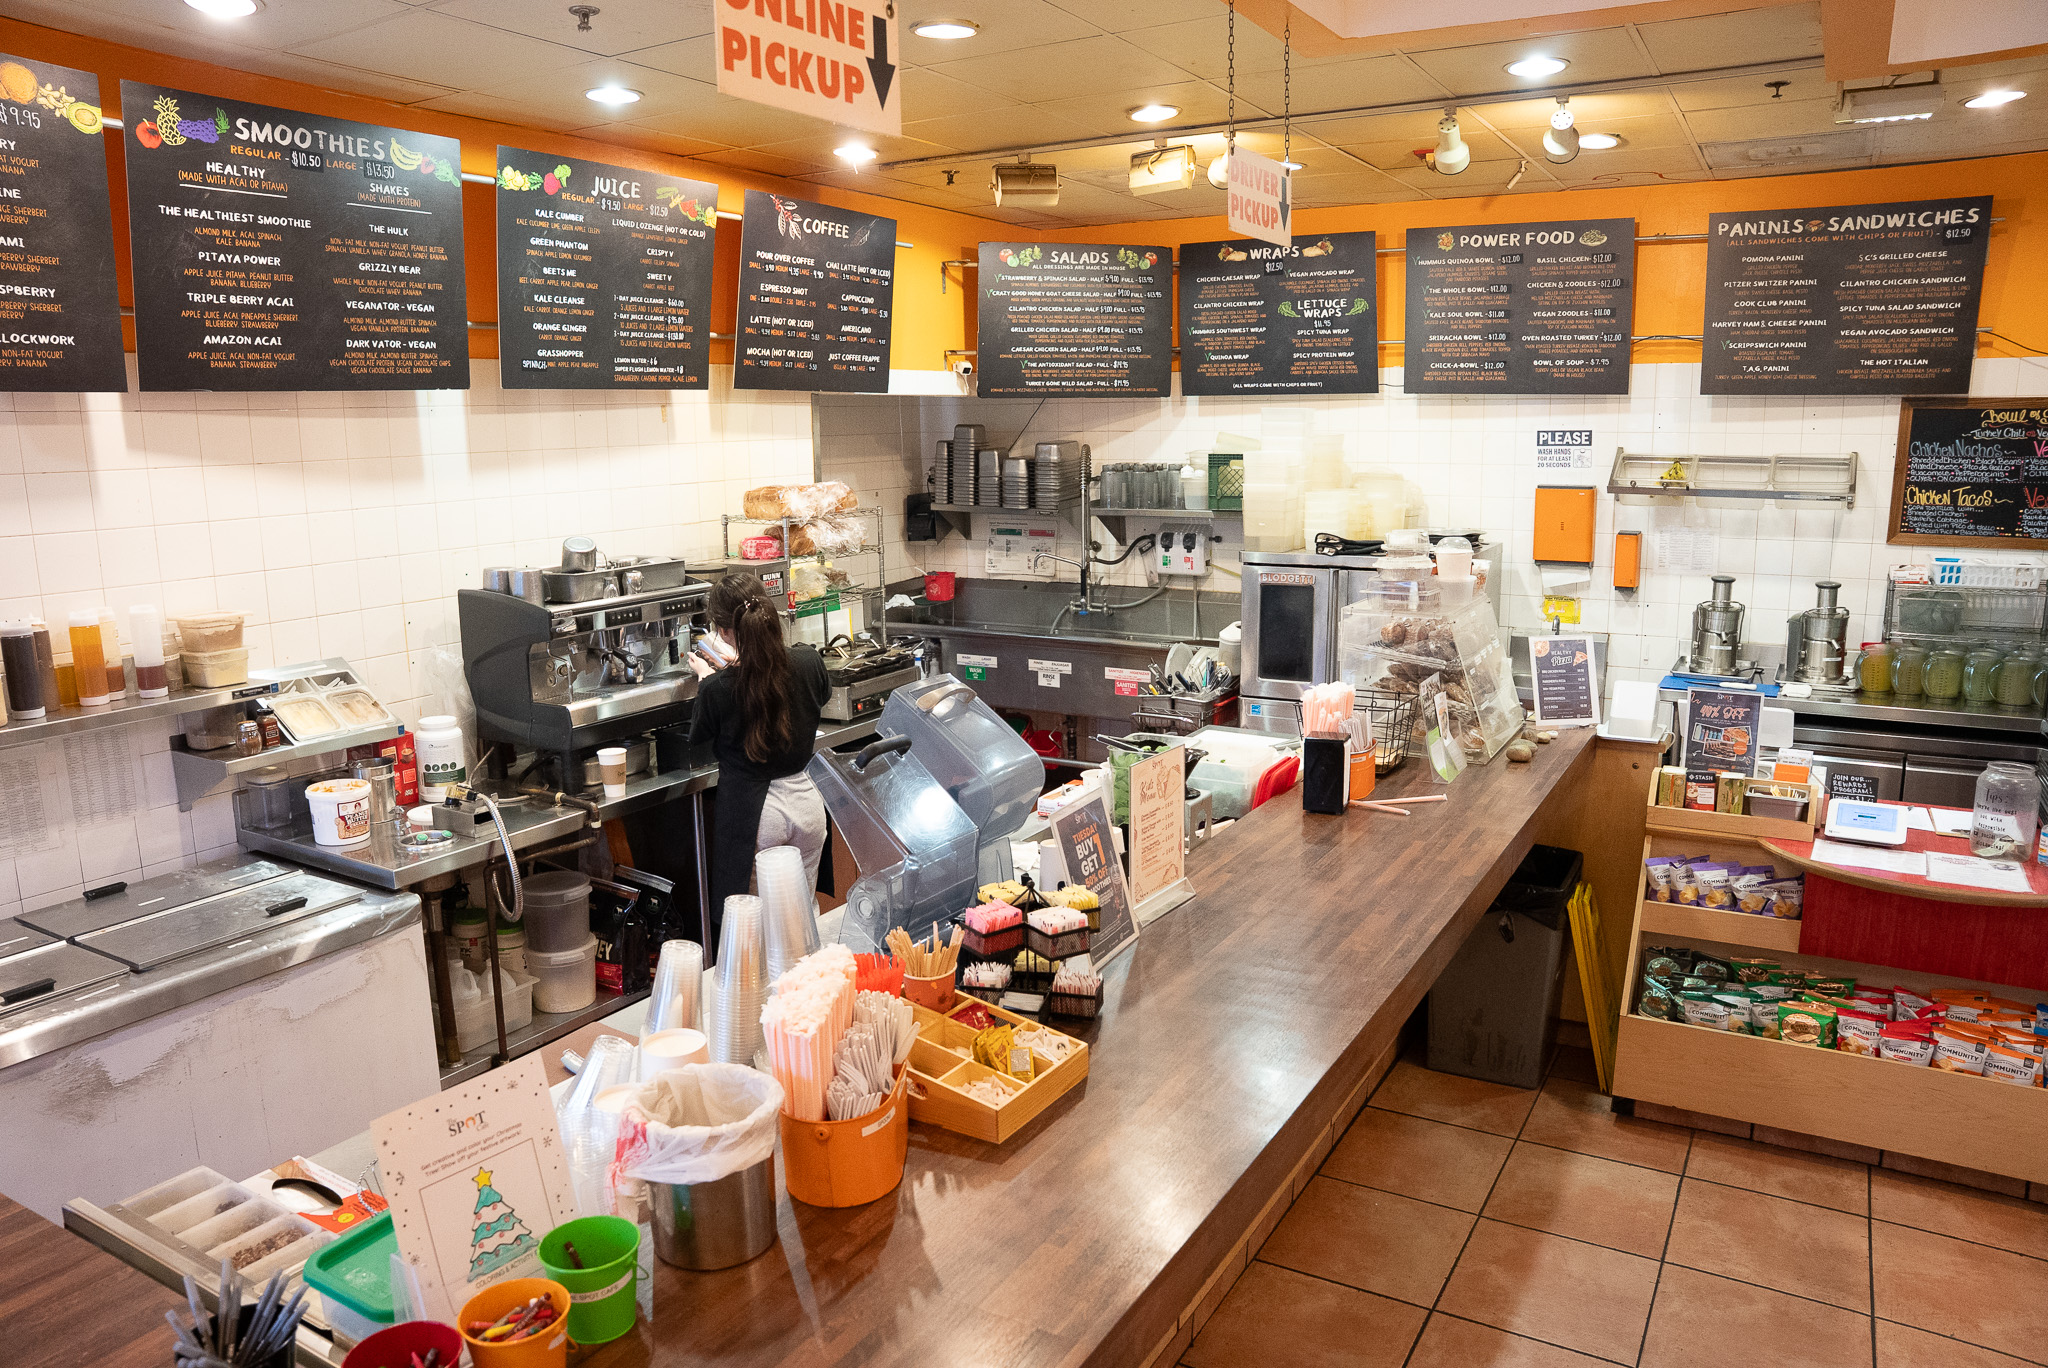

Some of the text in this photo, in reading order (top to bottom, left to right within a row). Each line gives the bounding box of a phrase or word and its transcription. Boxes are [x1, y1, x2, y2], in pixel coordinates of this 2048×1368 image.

[724, 0, 866, 50] LINE
[722, 26, 864, 104] PICKUP
[234, 117, 386, 160] SMOOTHIES
[230, 144, 394, 178] REGULAR $10.50 LARGE $13.50
[206, 162, 266, 178] HEALTHY
[178, 170, 288, 192] (MADE WITH ACAI OR PITAYA)
[1231, 159, 1278, 197] DRIVER
[370, 182, 410, 196] SHAKES
[591, 176, 641, 198] JUICE
[562, 192, 594, 204] REGULAR
[624, 202, 644, 212] LARGE
[158, 205, 312, 228] THE HEALTHIEST SMOOTHIE
[1231, 193, 1278, 230] PICKUP
[803, 218, 850, 238] COFFEE
[1718, 208, 1980, 237] PANINIS SANDWICHES
[530, 237, 588, 250] GREEN PHANTOM
[1460, 230, 1574, 248] POWER FOOD
[1726, 239, 1746, 247] (ALL
[1748, 236, 1802, 246] SANDWICHES
[1832, 234, 1856, 242] WITH
[1946, 228, 1971, 239] $12.50
[198, 252, 281, 266] PITAYA POWER
[756, 250, 815, 266] POUR OVER COFFEE
[1050, 252, 1109, 264] SALADS
[1250, 246, 1300, 260] WRAPS
[1501, 256, 1520, 264] $12.00
[358, 262, 420, 274] GRIZZLY BEAR
[542, 267, 576, 277] BEETS ME
[1600, 280, 1621, 288] $12.00
[1840, 279, 1880, 287] CILANTRO
[1920, 276, 1966, 284] SANDWICH
[760, 283, 808, 296] ESPRESSO SHOT
[842, 294, 874, 304] CAPPUCCINO
[1298, 298, 1347, 309] LETTUCE
[1304, 308, 1342, 318] WRAPS
[533, 323, 587, 333] ORANGE GINGER
[750, 315, 770, 324] LATTE
[772, 316, 786, 326] (HOT
[797, 319, 814, 329] ICED)
[0, 334, 75, 346] LOCKWORK
[1538, 432, 1590, 445] PLEASE
[762, 572, 780, 580] BUNN
[1262, 574, 1311, 584] BLODGETT
[1551, 656, 1572, 666] Pizza
[1833, 780, 1866, 788] REWARDS
[1072, 822, 1098, 844] TUESDAY
[1076, 833, 1106, 866] BUY 1
[1081, 853, 1098, 876] GET
[1085, 866, 1108, 888] 50% OFF
[1692, 1009, 1726, 1020] COMMUNITY
[1844, 1025, 1880, 1038] COMMUNITY
[1884, 1046, 1924, 1058] COMMUNITY
[1938, 1045, 1979, 1062] COMMUNITY
[1984, 1060, 2028, 1078] COMMUNITY
[432, 1154, 454, 1166] creative
[483, 1135, 494, 1144] your
[496, 1123, 522, 1136] Christmas
[476, 1271, 506, 1289] COLORING
[510, 1254, 536, 1270] ACTIVITY
[580, 1292, 599, 1300] SPOT
